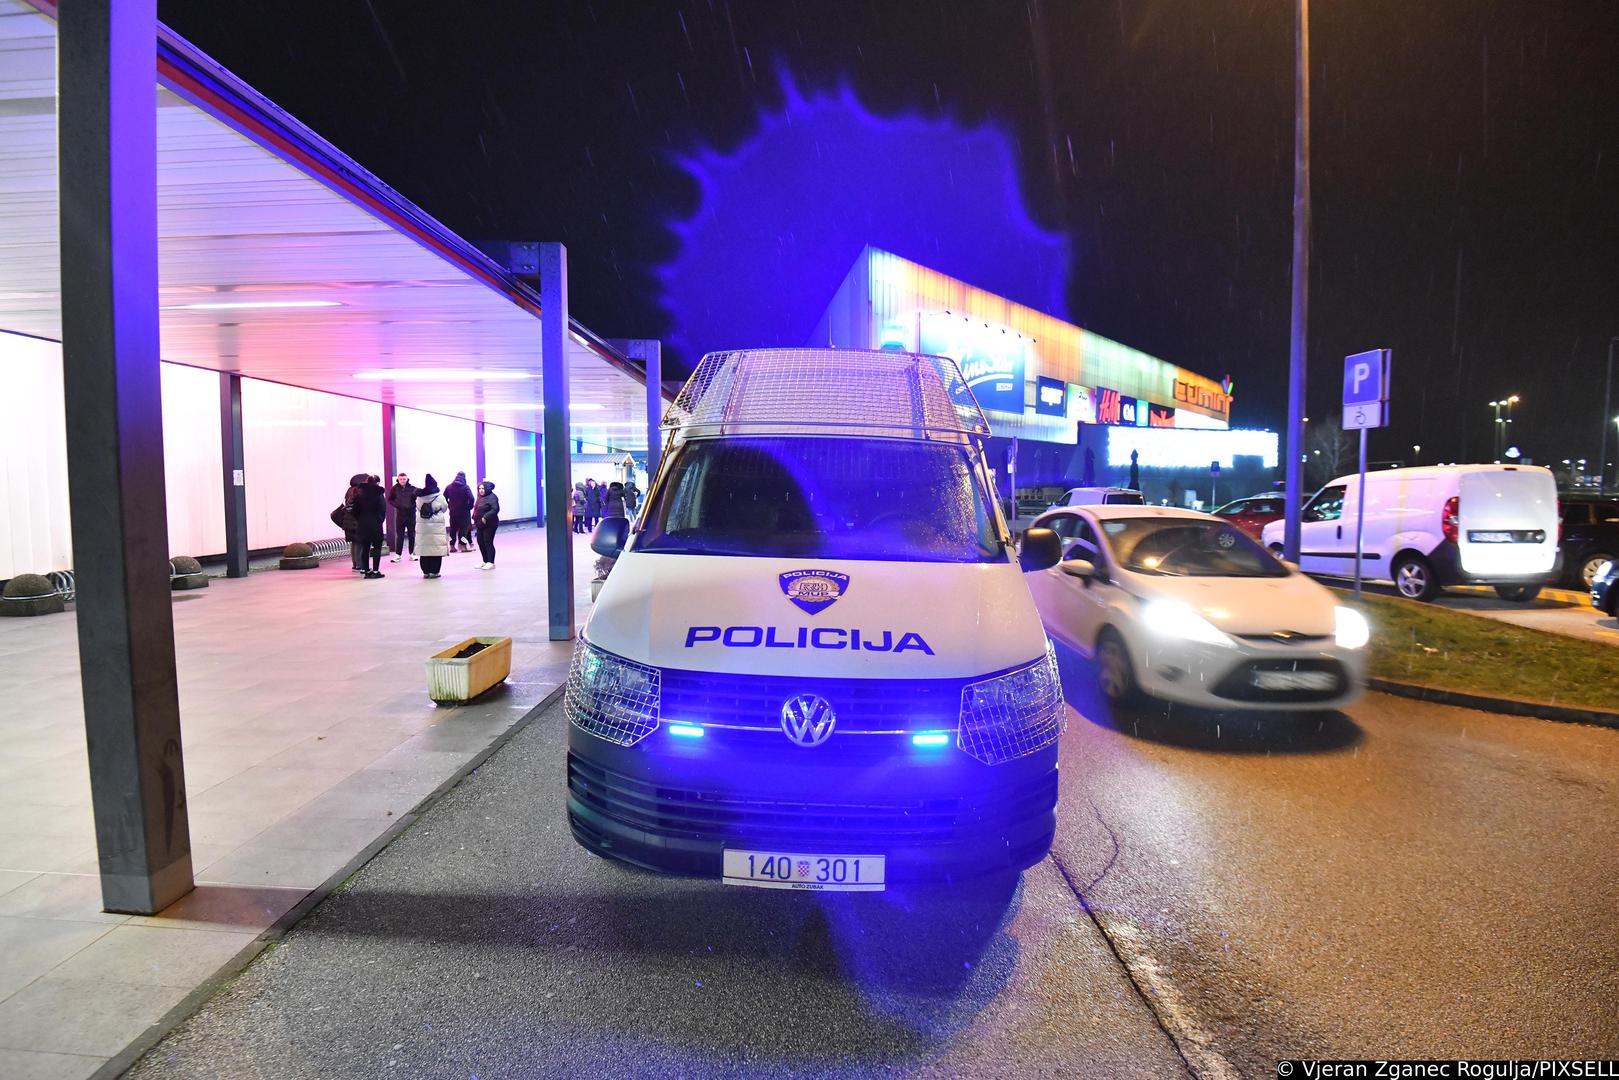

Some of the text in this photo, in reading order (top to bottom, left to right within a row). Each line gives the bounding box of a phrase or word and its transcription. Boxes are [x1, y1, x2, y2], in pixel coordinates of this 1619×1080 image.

[1353, 363, 1370, 394] P
[783, 571, 847, 580] POLICIJA
[685, 626, 936, 656] POLICIJA
[748, 855, 860, 882] 140 301
